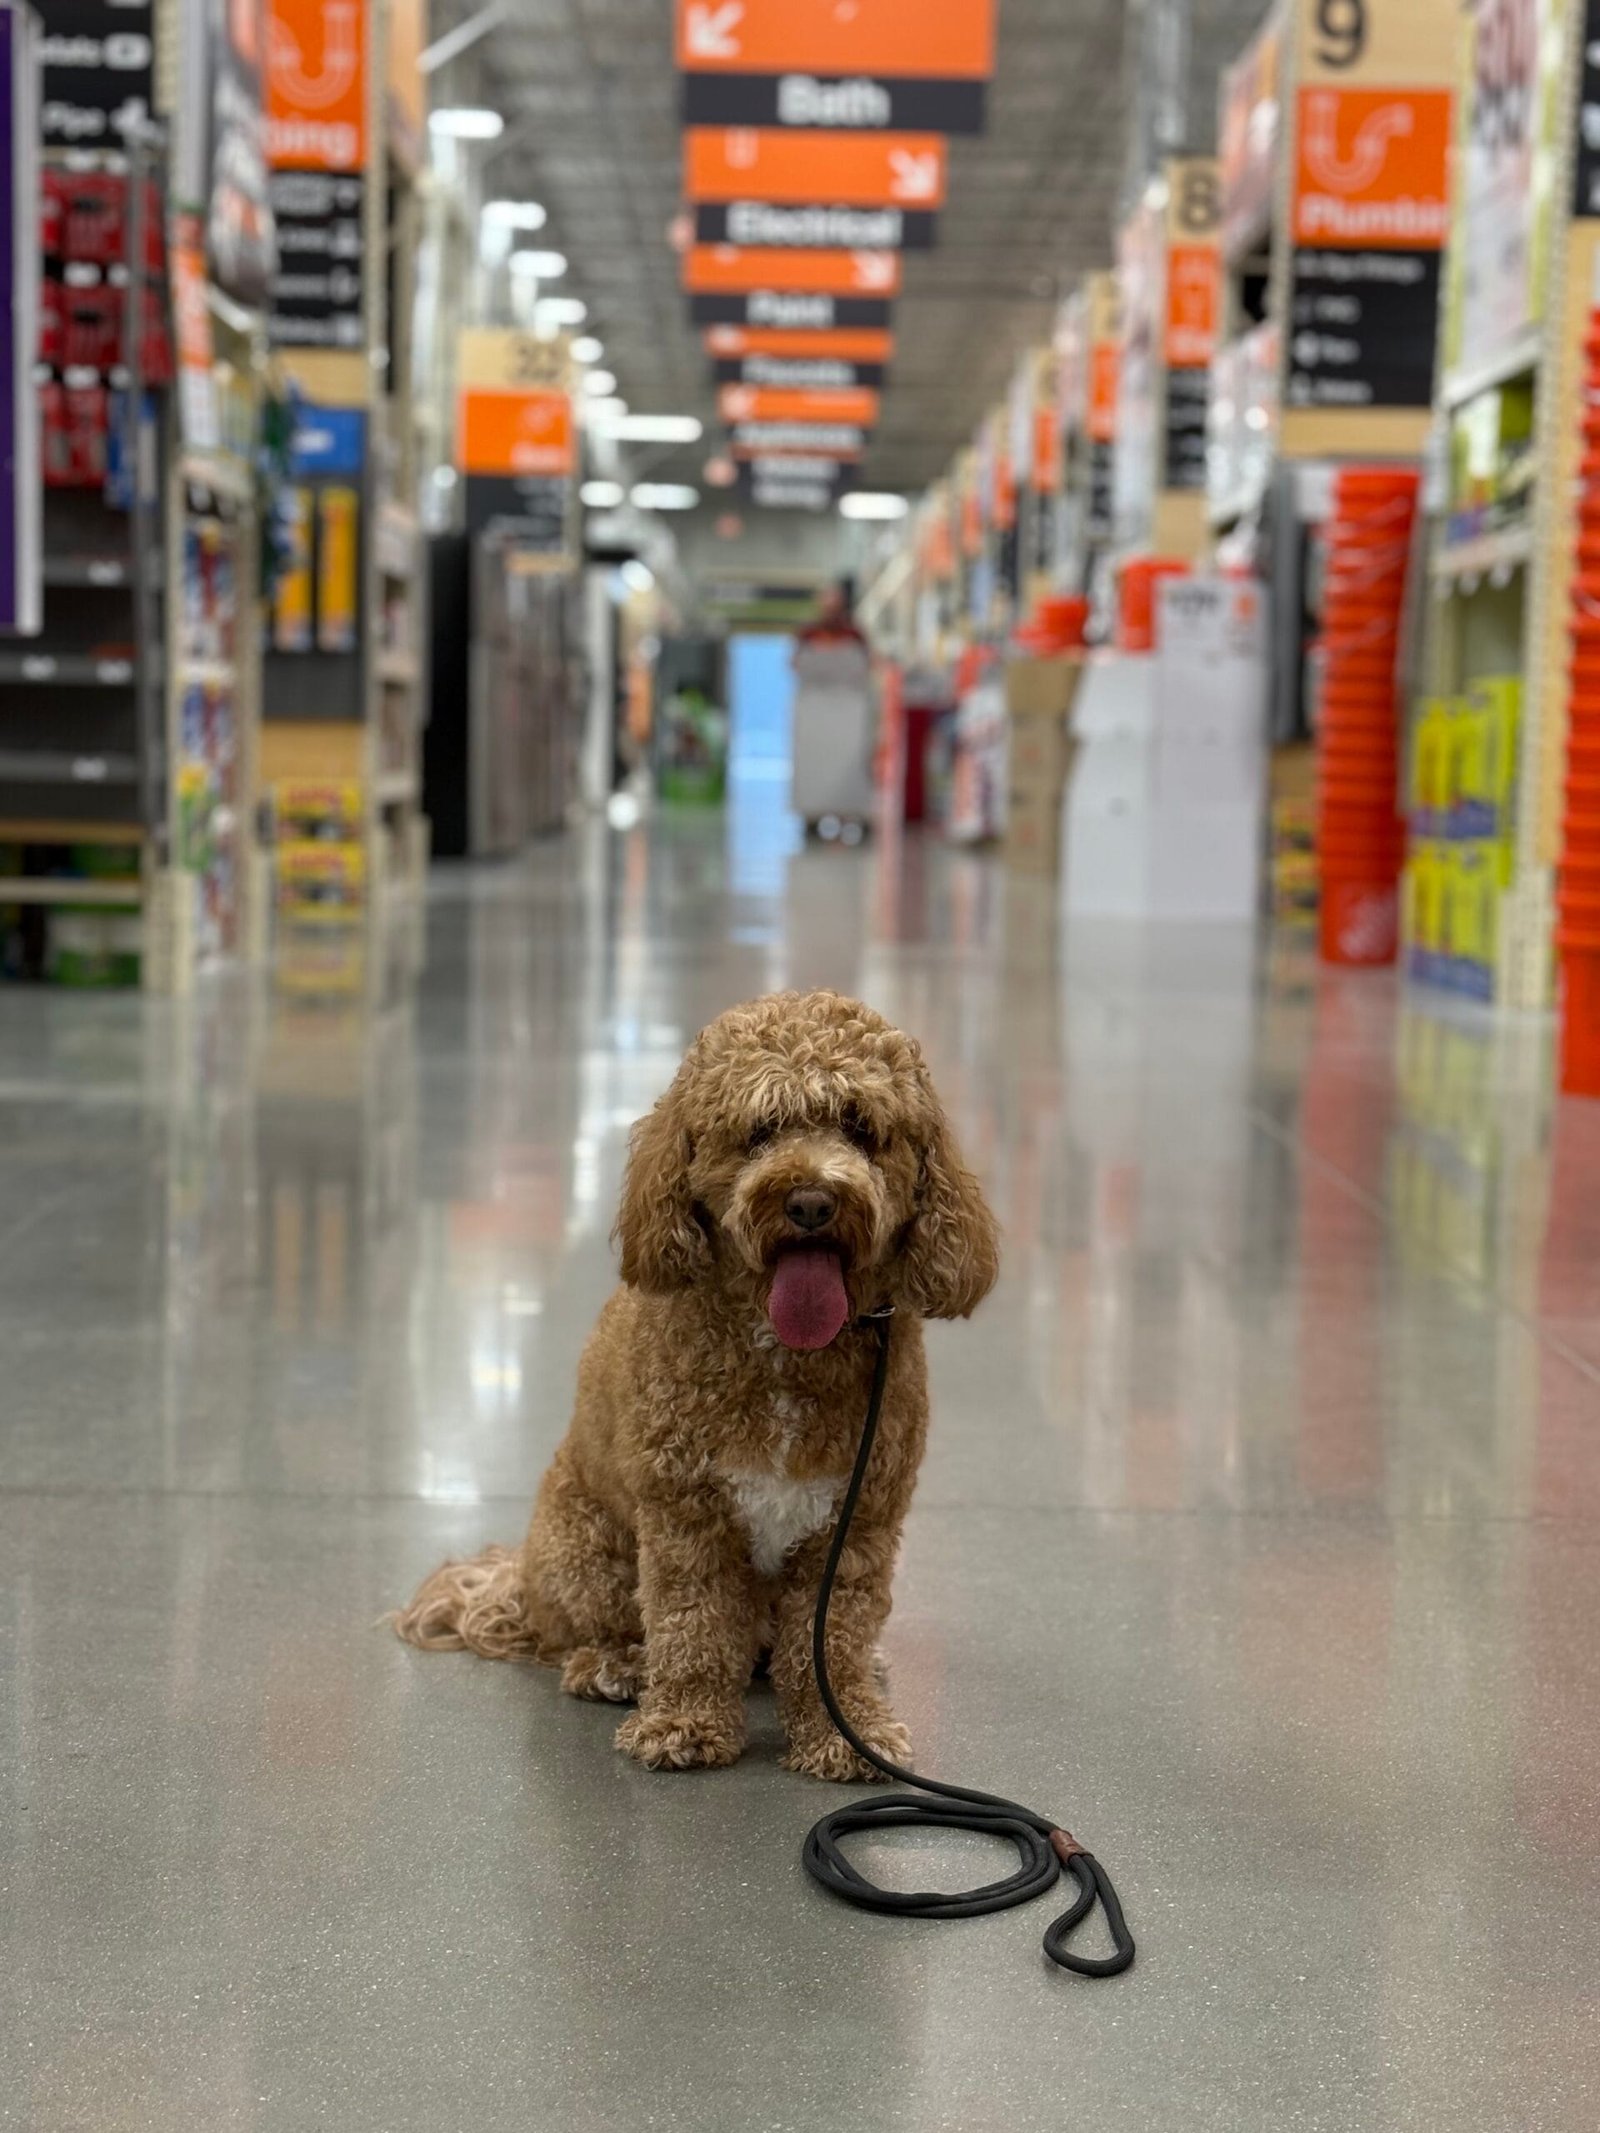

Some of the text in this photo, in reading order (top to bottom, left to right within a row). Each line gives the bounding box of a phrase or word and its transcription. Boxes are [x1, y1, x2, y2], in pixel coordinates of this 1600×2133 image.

[1314, 0, 1367, 69] 9
[778, 75, 890, 127] Bath
[727, 202, 902, 246] Electrical
